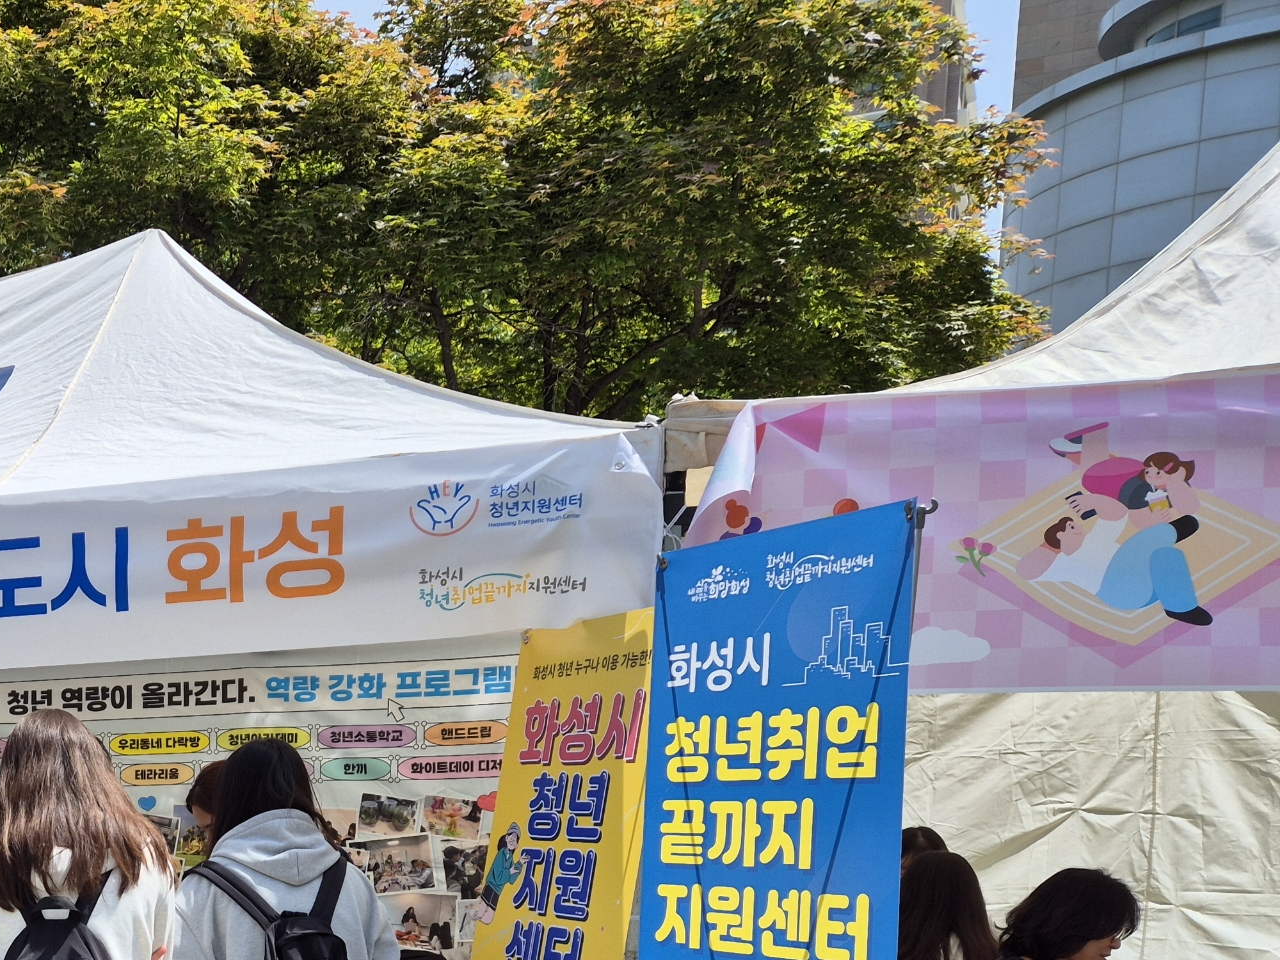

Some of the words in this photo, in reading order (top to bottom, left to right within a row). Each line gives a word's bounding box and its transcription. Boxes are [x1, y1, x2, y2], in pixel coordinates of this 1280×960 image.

[489, 481, 536, 499] 화성시
[489, 493, 583, 519] 청년지원센터
[165, 505, 347, 604] 화성
[766, 551, 794, 569] 화성시
[419, 567, 463, 586] 화성시
[708, 577, 750, 599] 희망화성
[533, 663, 556, 681] 화성시
[557, 661, 574, 678] 청년
[574, 657, 600, 675] 누구나
[601, 654, 619, 671] 이용
[621, 649, 652, 669] 가능한!
[666, 631, 771, 694] 화성시
[7, 689, 53, 716] 청년
[61, 684, 132, 713] 역량이
[141, 677, 256, 710] 올라간다.
[266, 675, 320, 703] 역량
[328, 672, 387, 702] 강화
[330, 729, 403, 744] 청년소통학교
[440, 726, 492, 740] 핸드드립
[519, 688, 646, 765] 화성시
[118, 739, 163, 750] 우리동네
[165, 737, 201, 749] 다락방
[664, 702, 880, 785] 청년취업
[134, 768, 179, 780] 테라리움
[343, 763, 368, 775] 한끼
[410, 760, 475, 774] 화이트데이
[478, 759, 503, 772] 디저
[527, 771, 609, 843] 청년
[659, 797, 815, 870] 끝까지
[513, 848, 596, 922] 지원
